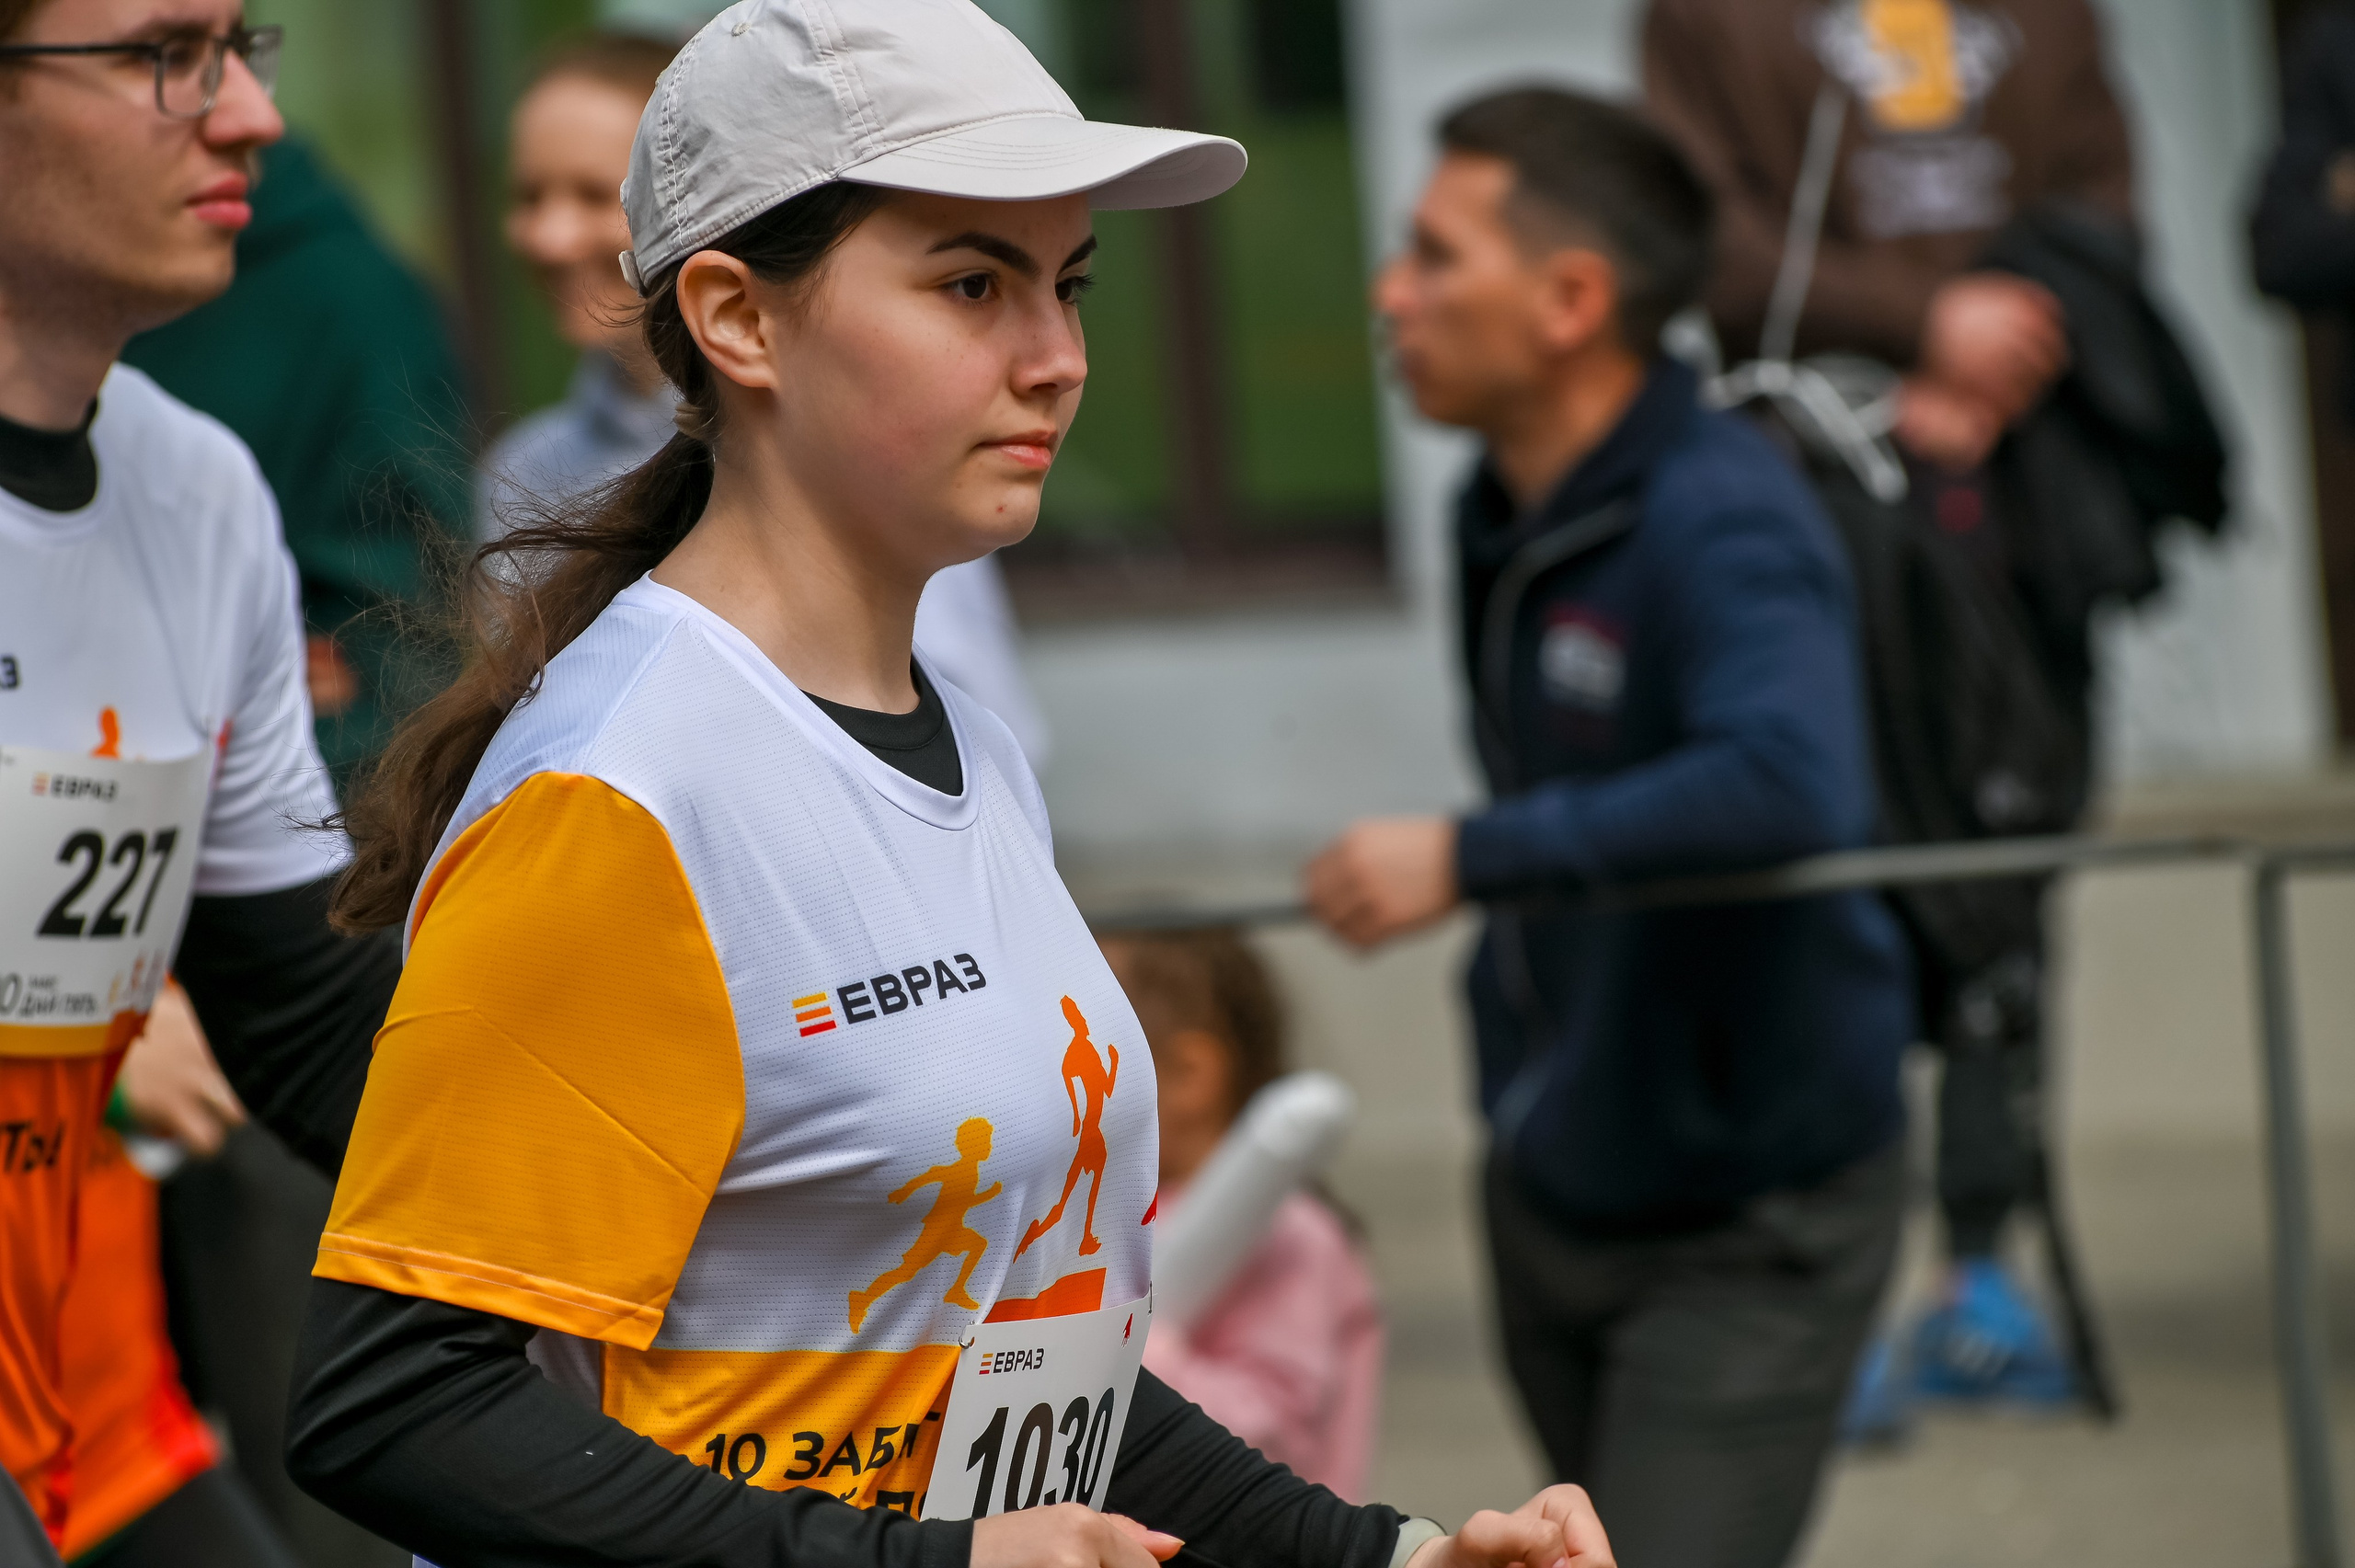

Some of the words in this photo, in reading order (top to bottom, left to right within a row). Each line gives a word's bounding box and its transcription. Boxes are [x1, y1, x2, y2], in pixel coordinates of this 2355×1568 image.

[51, 773, 118, 803] ЕВРАЗ
[37, 827, 178, 939] 227
[836, 953, 987, 1024] ЕВРАЗ
[993, 1348, 1045, 1374] ЕВРАЗ
[705, 1432, 767, 1480] 10
[966, 1387, 1115, 1518] 1030
